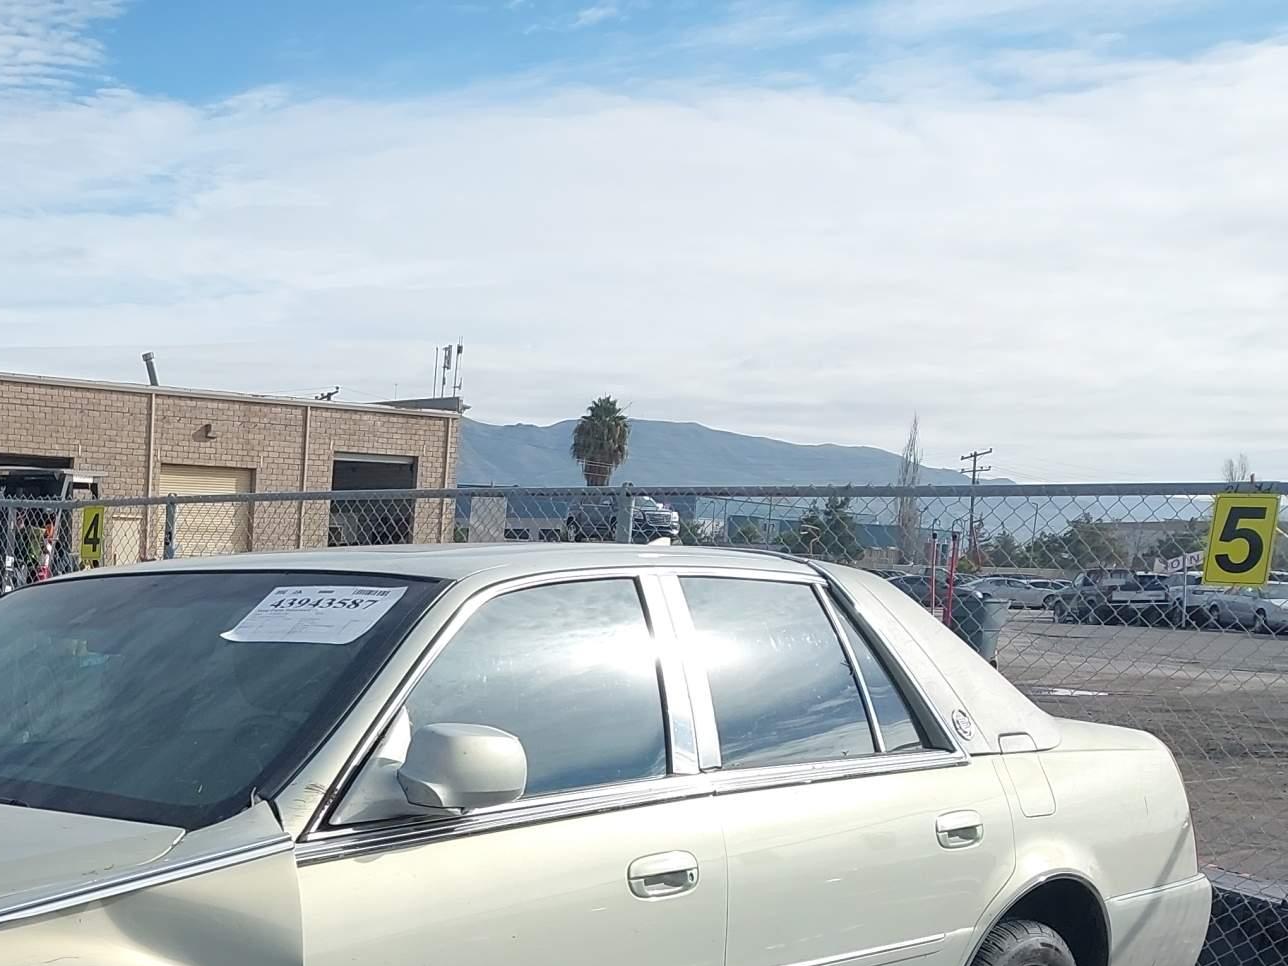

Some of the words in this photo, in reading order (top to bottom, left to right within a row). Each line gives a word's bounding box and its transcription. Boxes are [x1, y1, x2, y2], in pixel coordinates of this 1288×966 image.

[83, 513, 100, 552] 4
[1214, 506, 1268, 574] 5
[270, 597, 379, 610] 43943587
